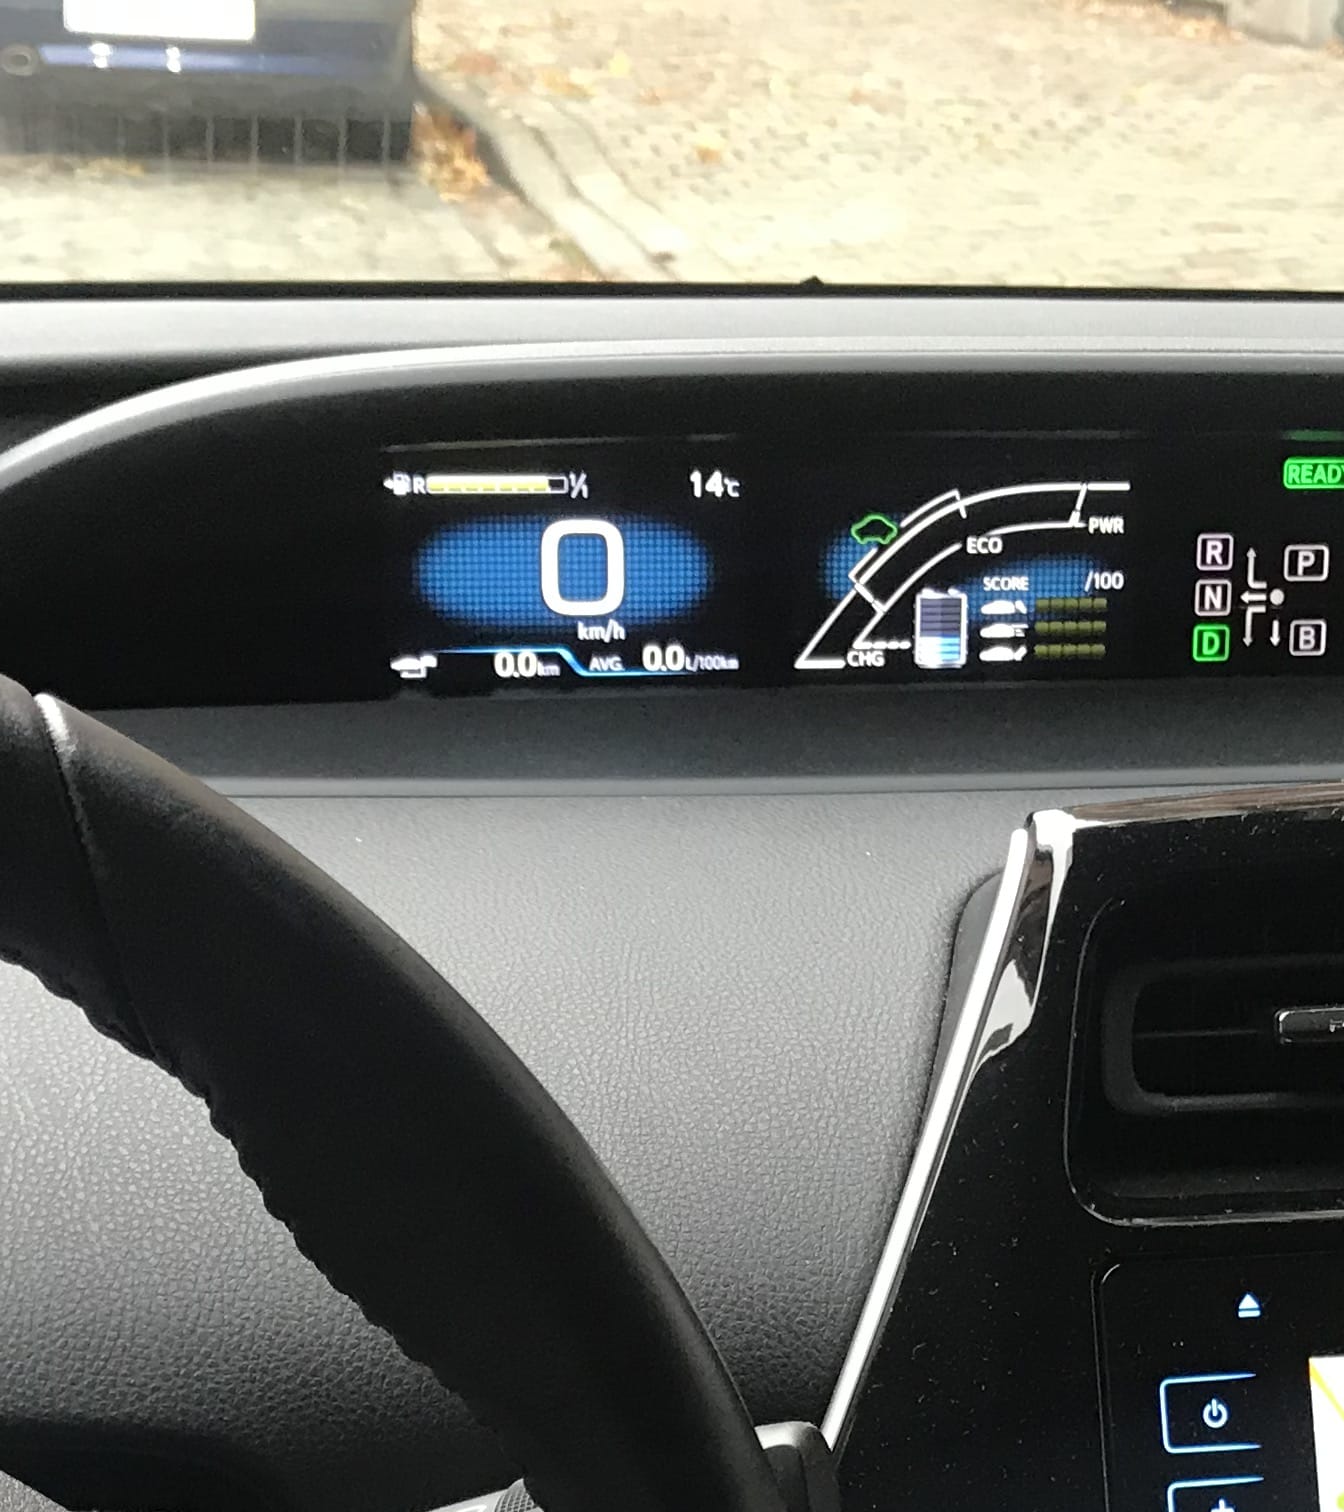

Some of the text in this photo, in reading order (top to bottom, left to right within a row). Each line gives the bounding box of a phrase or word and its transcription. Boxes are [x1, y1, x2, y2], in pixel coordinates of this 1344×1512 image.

[1088, 516, 1125, 534] PWR
[966, 537, 1003, 554] ECO
[1206, 542, 1222, 565] R
[540, 519, 625, 616] 0
[1297, 552, 1315, 576] P
[983, 576, 1029, 591] SCORE
[1204, 586, 1222, 609] N
[577, 618, 625, 643] km/h
[1299, 626, 1316, 650] B
[1201, 632, 1220, 655] D
[847, 649, 885, 668] CHG
